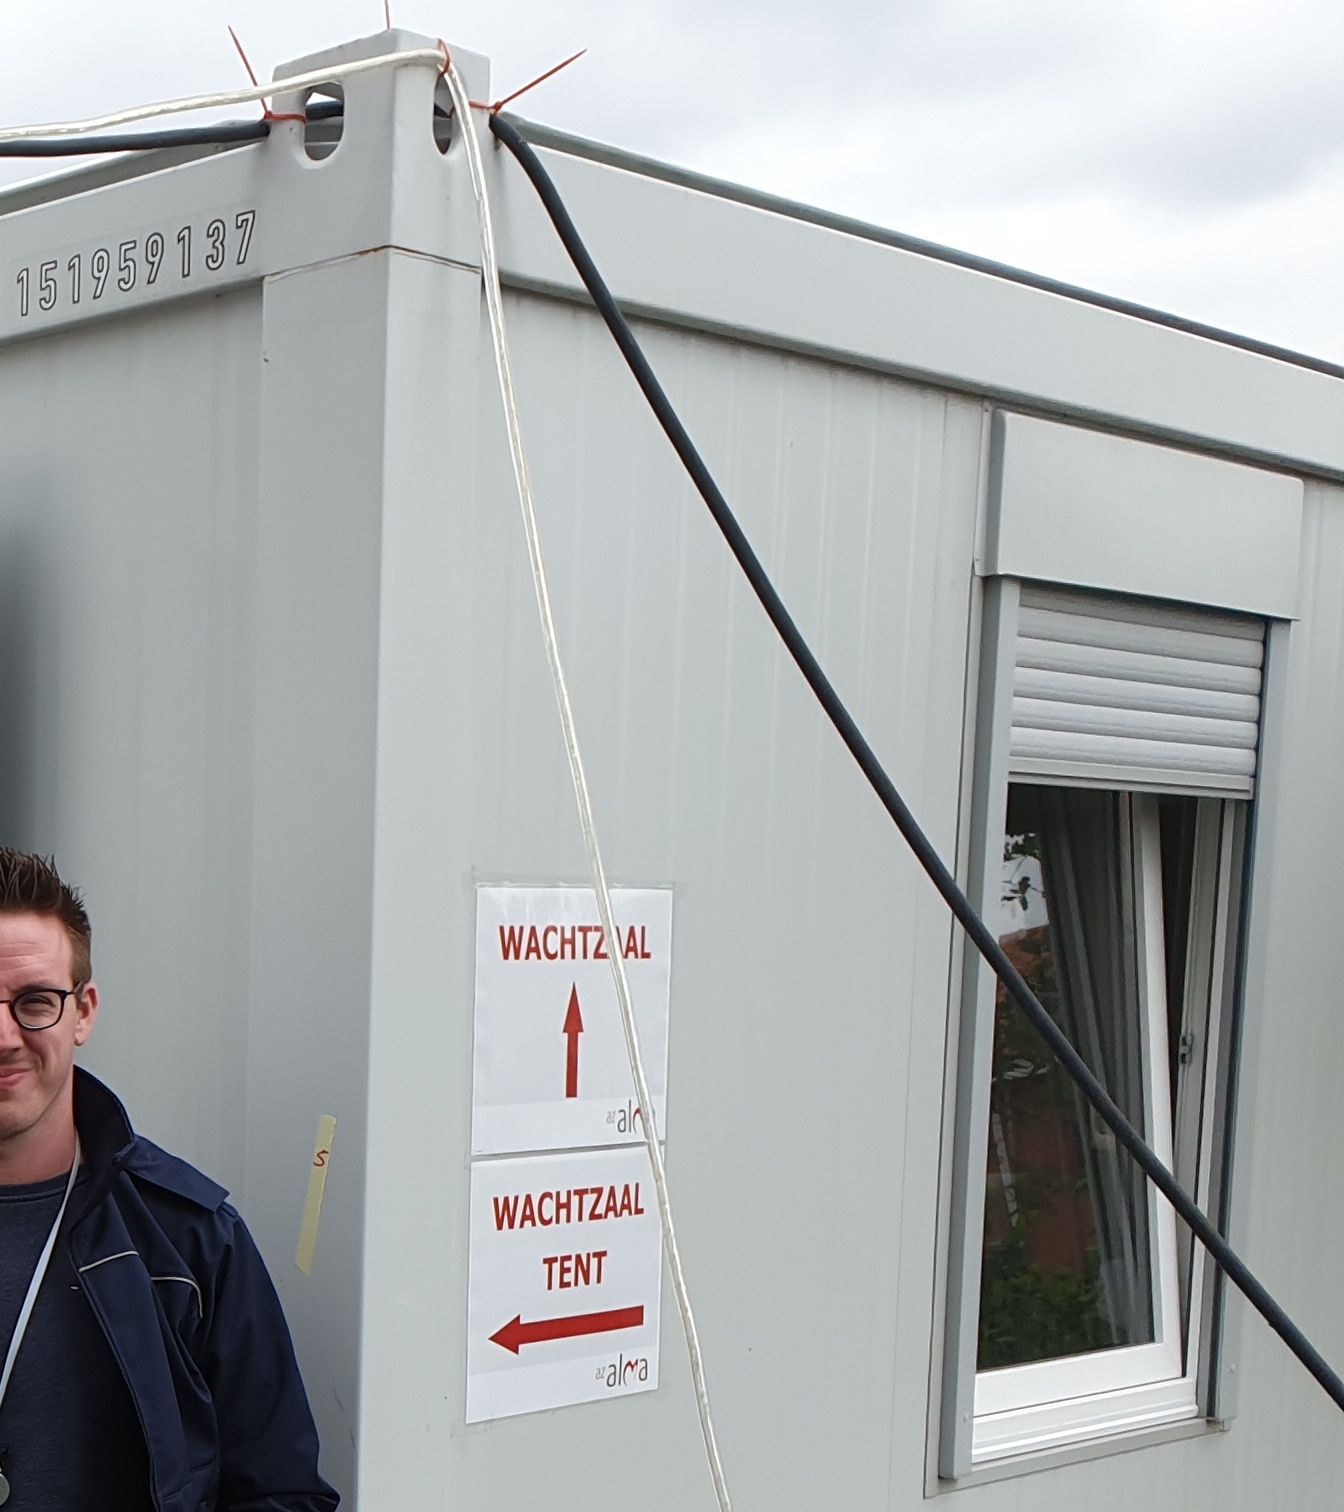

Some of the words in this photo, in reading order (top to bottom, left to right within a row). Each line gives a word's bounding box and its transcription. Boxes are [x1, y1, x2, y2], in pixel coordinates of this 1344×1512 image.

[16, 209, 256, 317] 151959137
[491, 1182, 645, 1232] WACHTZAAL
[542, 1250, 608, 1291] TENT
[606, 1353, 649, 1389] alma
